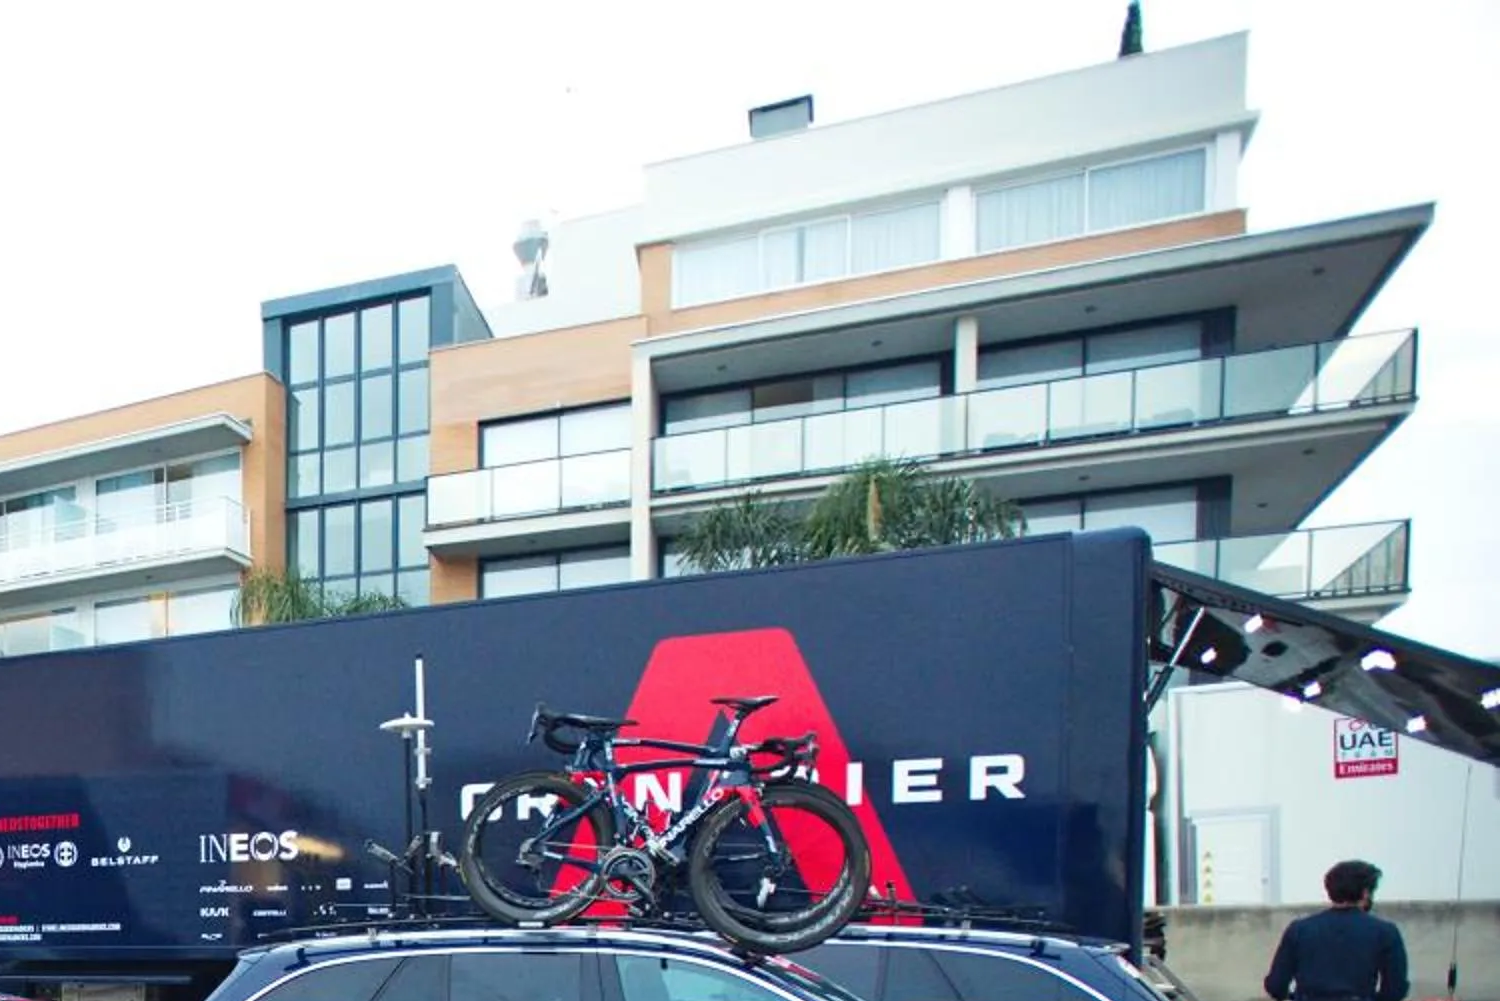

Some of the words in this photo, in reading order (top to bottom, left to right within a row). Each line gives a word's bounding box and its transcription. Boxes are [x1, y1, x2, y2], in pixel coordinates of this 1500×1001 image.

[1339, 731, 1393, 751] UAE
[7, 844, 51, 859] INEOS
[199, 830, 299, 863] INEOS
[91, 855, 159, 867] BELSTAFF
